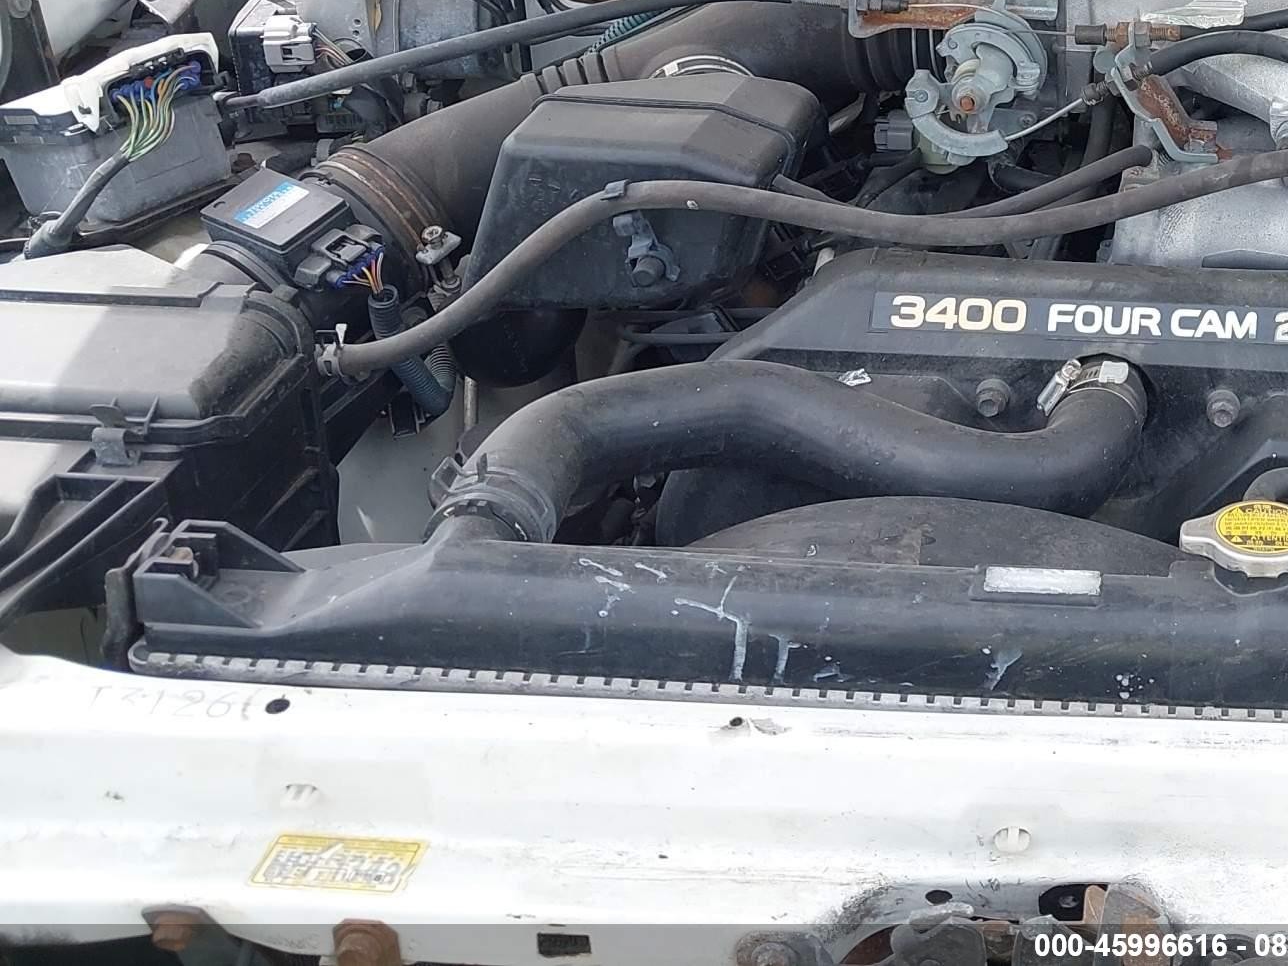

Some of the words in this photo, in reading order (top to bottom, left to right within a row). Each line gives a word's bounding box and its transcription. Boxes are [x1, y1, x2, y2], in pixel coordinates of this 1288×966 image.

[890, 295, 1028, 332] 3400
[1047, 303, 1162, 336] FOUR
[1169, 308, 1258, 339] CAM
